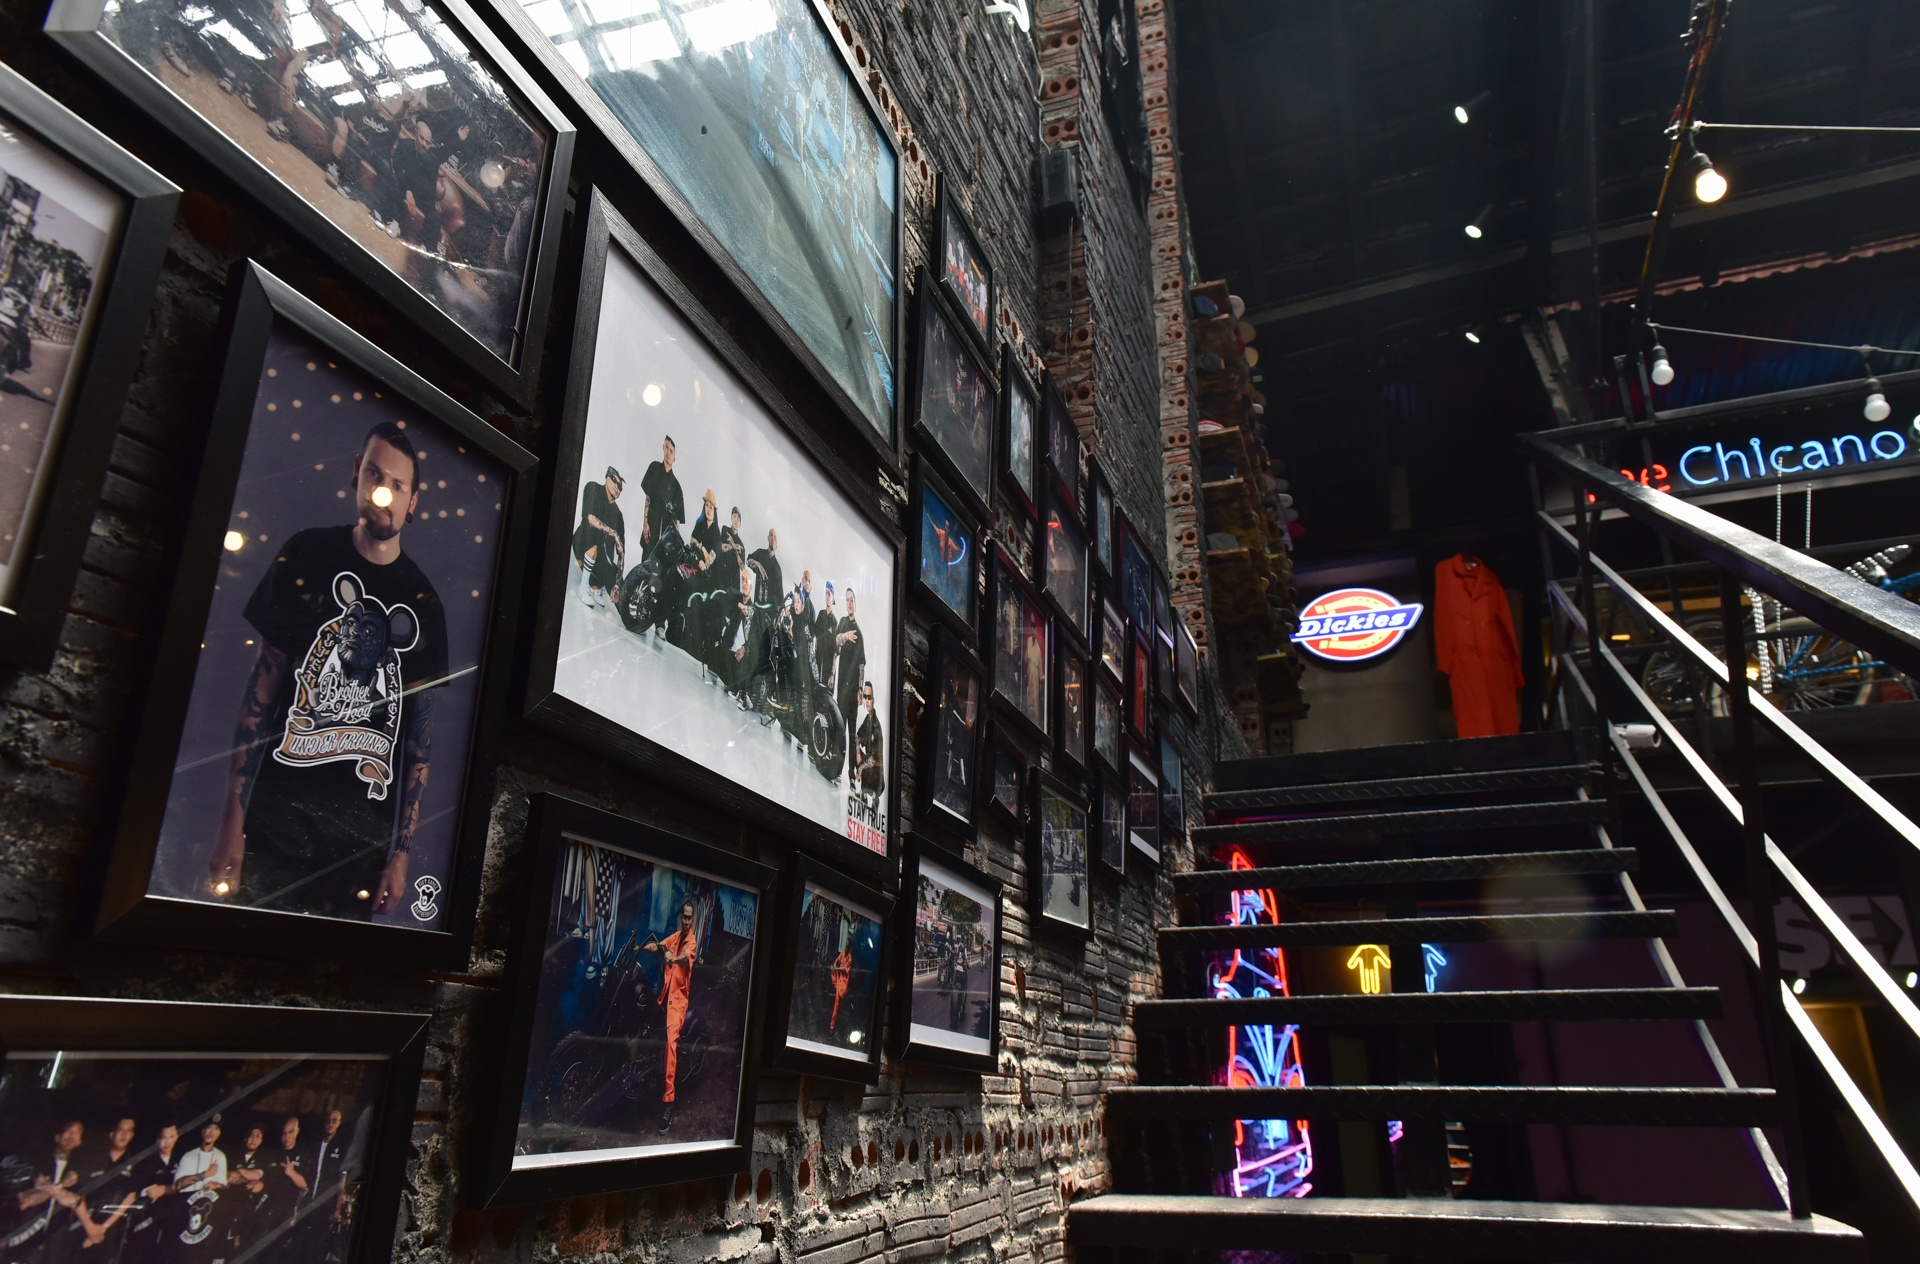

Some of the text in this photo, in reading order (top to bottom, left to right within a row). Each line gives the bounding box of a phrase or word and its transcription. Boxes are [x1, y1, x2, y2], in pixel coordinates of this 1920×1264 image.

[1679, 430, 1905, 485] Chicano
[1295, 612, 1407, 637] Dickies
[318, 672, 371, 703] Brother
[331, 699, 374, 724] Hood
[289, 731, 390, 756] UNDER GROUND
[848, 795, 886, 834] STAY TRUE
[847, 817, 885, 855] STAY FREE
